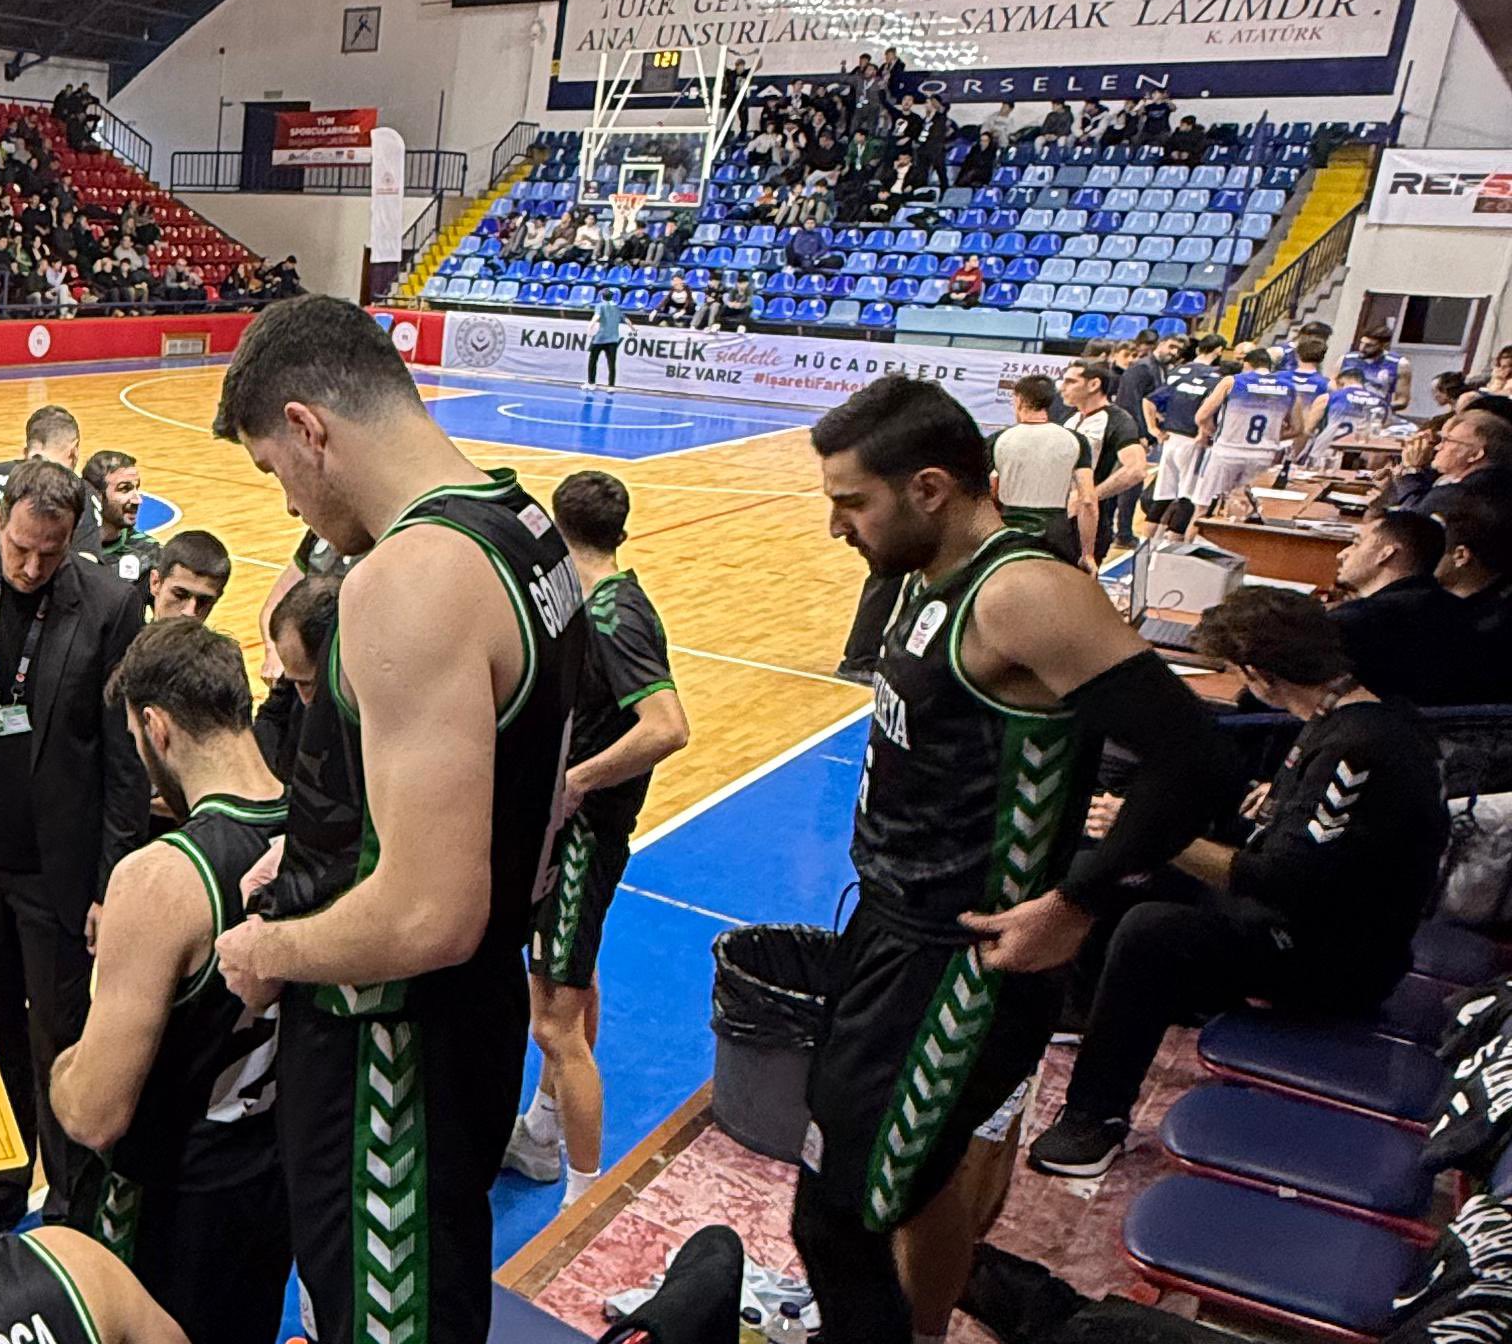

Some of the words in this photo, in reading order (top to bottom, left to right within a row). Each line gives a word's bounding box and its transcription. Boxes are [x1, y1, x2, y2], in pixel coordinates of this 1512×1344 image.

[576, 26, 635, 52] ANA
[654, 10, 938, 50] UNSURLARINDN
[960, 0, 1115, 34] SAYMAK
[1230, 24, 1324, 44] ATATÜRK
[900, 73, 1170, 97] ORSELEN
[520, 328, 591, 352] KADIN
[665, 364, 691, 380] BİZ
[695, 366, 743, 384] VARIZ
[1001, 362, 1019, 373] 25
[1245, 414, 1268, 445] 8
